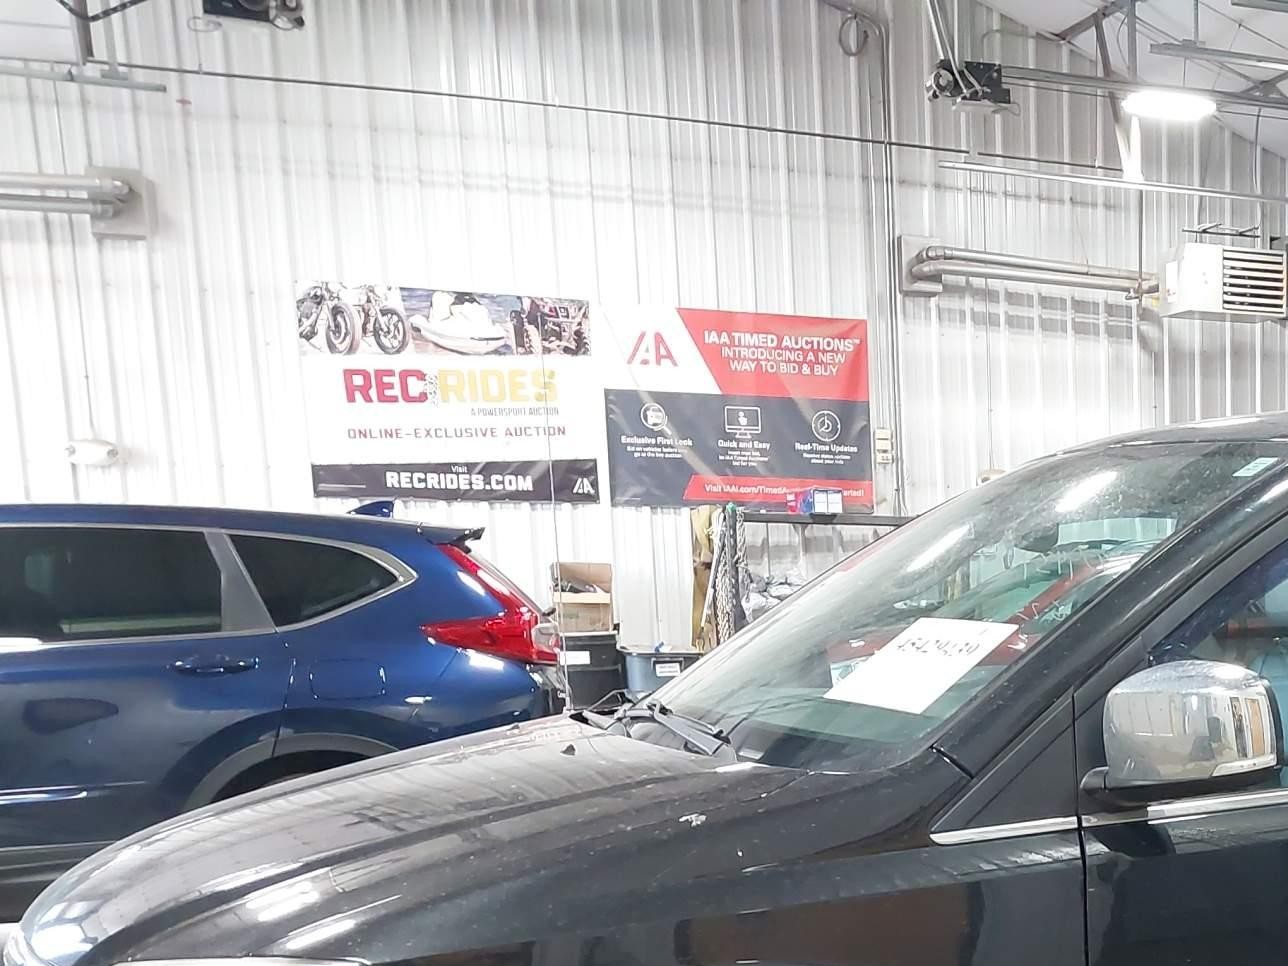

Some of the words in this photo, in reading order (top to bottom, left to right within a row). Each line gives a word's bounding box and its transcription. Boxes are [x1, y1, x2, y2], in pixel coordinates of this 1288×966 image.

[704, 330, 731, 345] IAA
[732, 332, 778, 347] TIMED
[721, 348, 804, 363] INTRODUCING
[806, 351, 818, 362] A
[819, 352, 846, 364] NEW
[730, 361, 758, 373] WAY
[760, 363, 776, 374] TO
[779, 364, 800, 375] BID
[801, 365, 811, 375] &
[813, 366, 839, 377] BUY
[343, 368, 429, 404] REC
[437, 369, 559, 404] RIDES
[471, 407, 477, 417] A
[477, 407, 527, 417] POWERSPORT
[528, 407, 560, 417] AUCTION
[347, 427, 499, 440] ONLINE-EXCLUSIVE
[504, 426, 567, 438] AUCTION
[621, 435, 656, 445] Exclusive
[657, 436, 674, 446] First
[675, 437, 693, 447] Look
[717, 439, 738, 449] Quick
[739, 441, 753, 449] and
[753, 441, 771, 451] Easy
[794, 442, 830, 452] Real-Time
[831, 444, 859, 454] Updates
[451, 464, 468, 473] Visit
[385, 471, 534, 491] RECRIDES.COM
[704, 483, 721, 493] Visit
